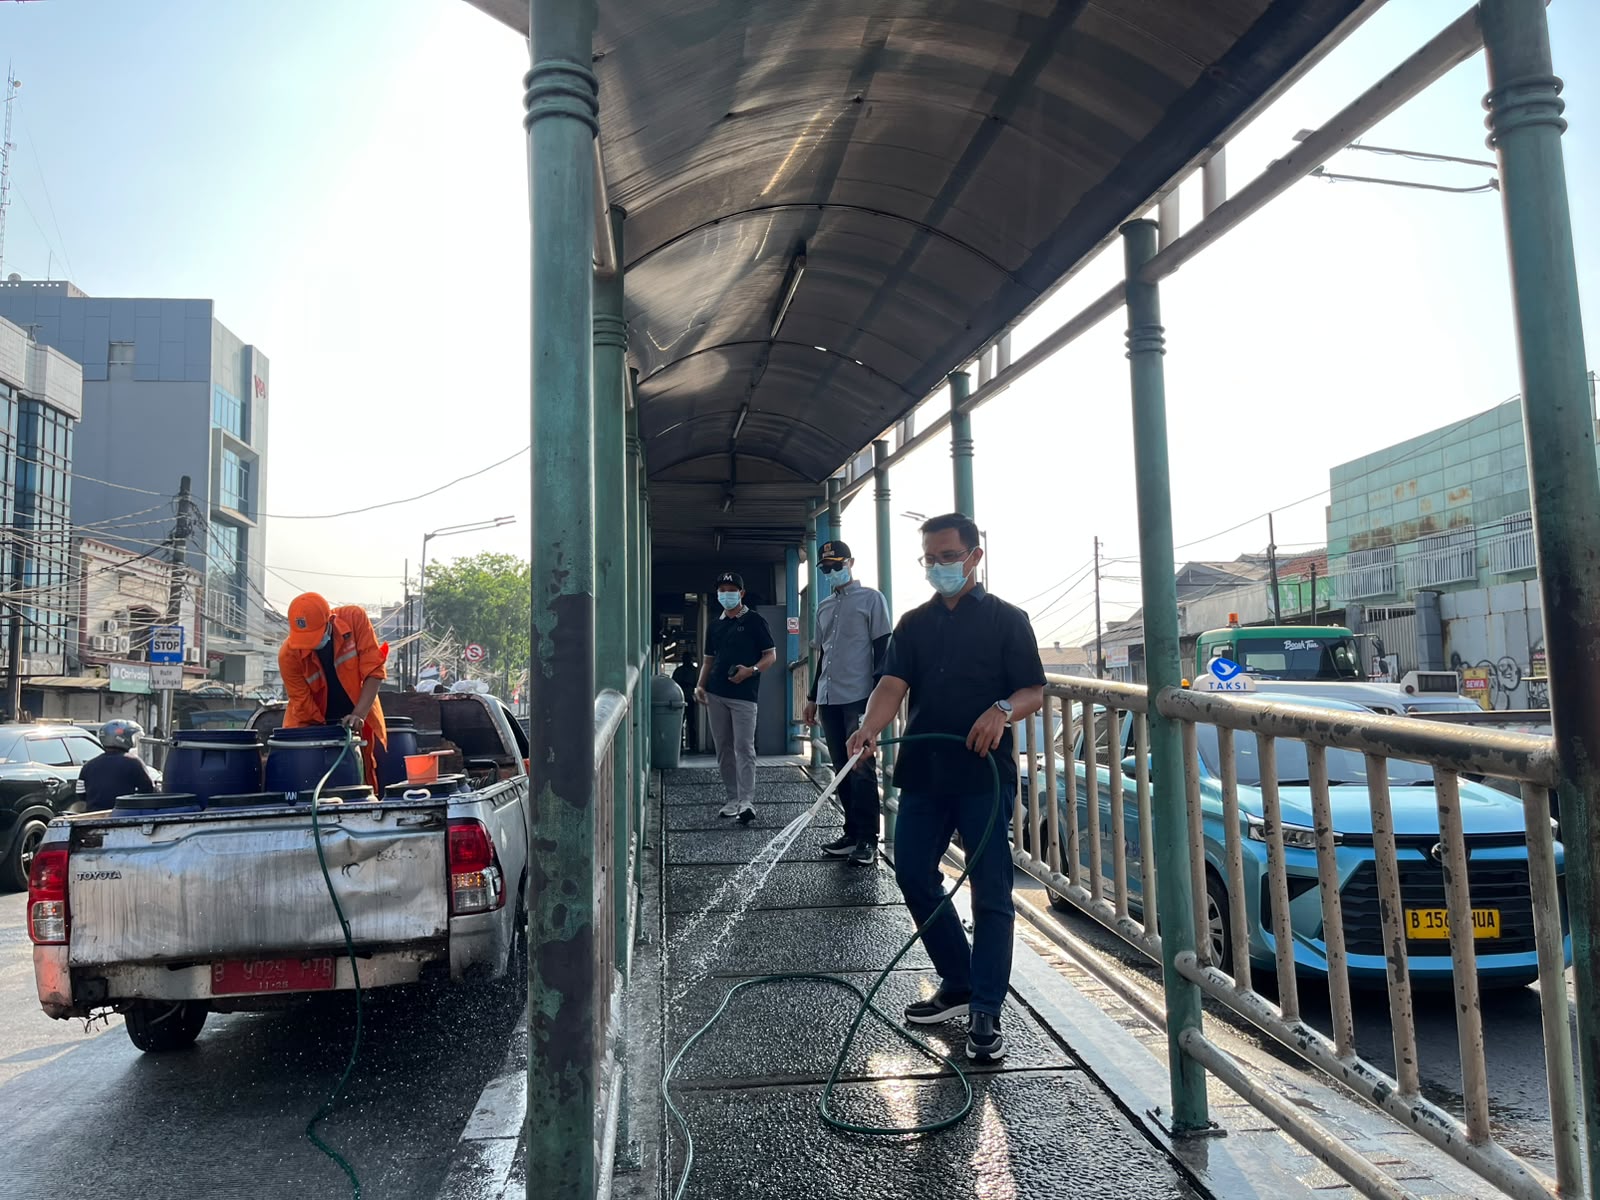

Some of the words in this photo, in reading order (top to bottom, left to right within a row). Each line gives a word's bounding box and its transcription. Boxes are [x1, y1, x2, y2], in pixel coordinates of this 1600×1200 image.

[154, 641, 179, 650] STOP
[1209, 682, 1247, 690] TAKSI
[1466, 680, 1485, 688] SEWA
[77, 870, 122, 881] TOYOTA
[1411, 911, 1420, 928] B
[214, 963, 224, 982] B
